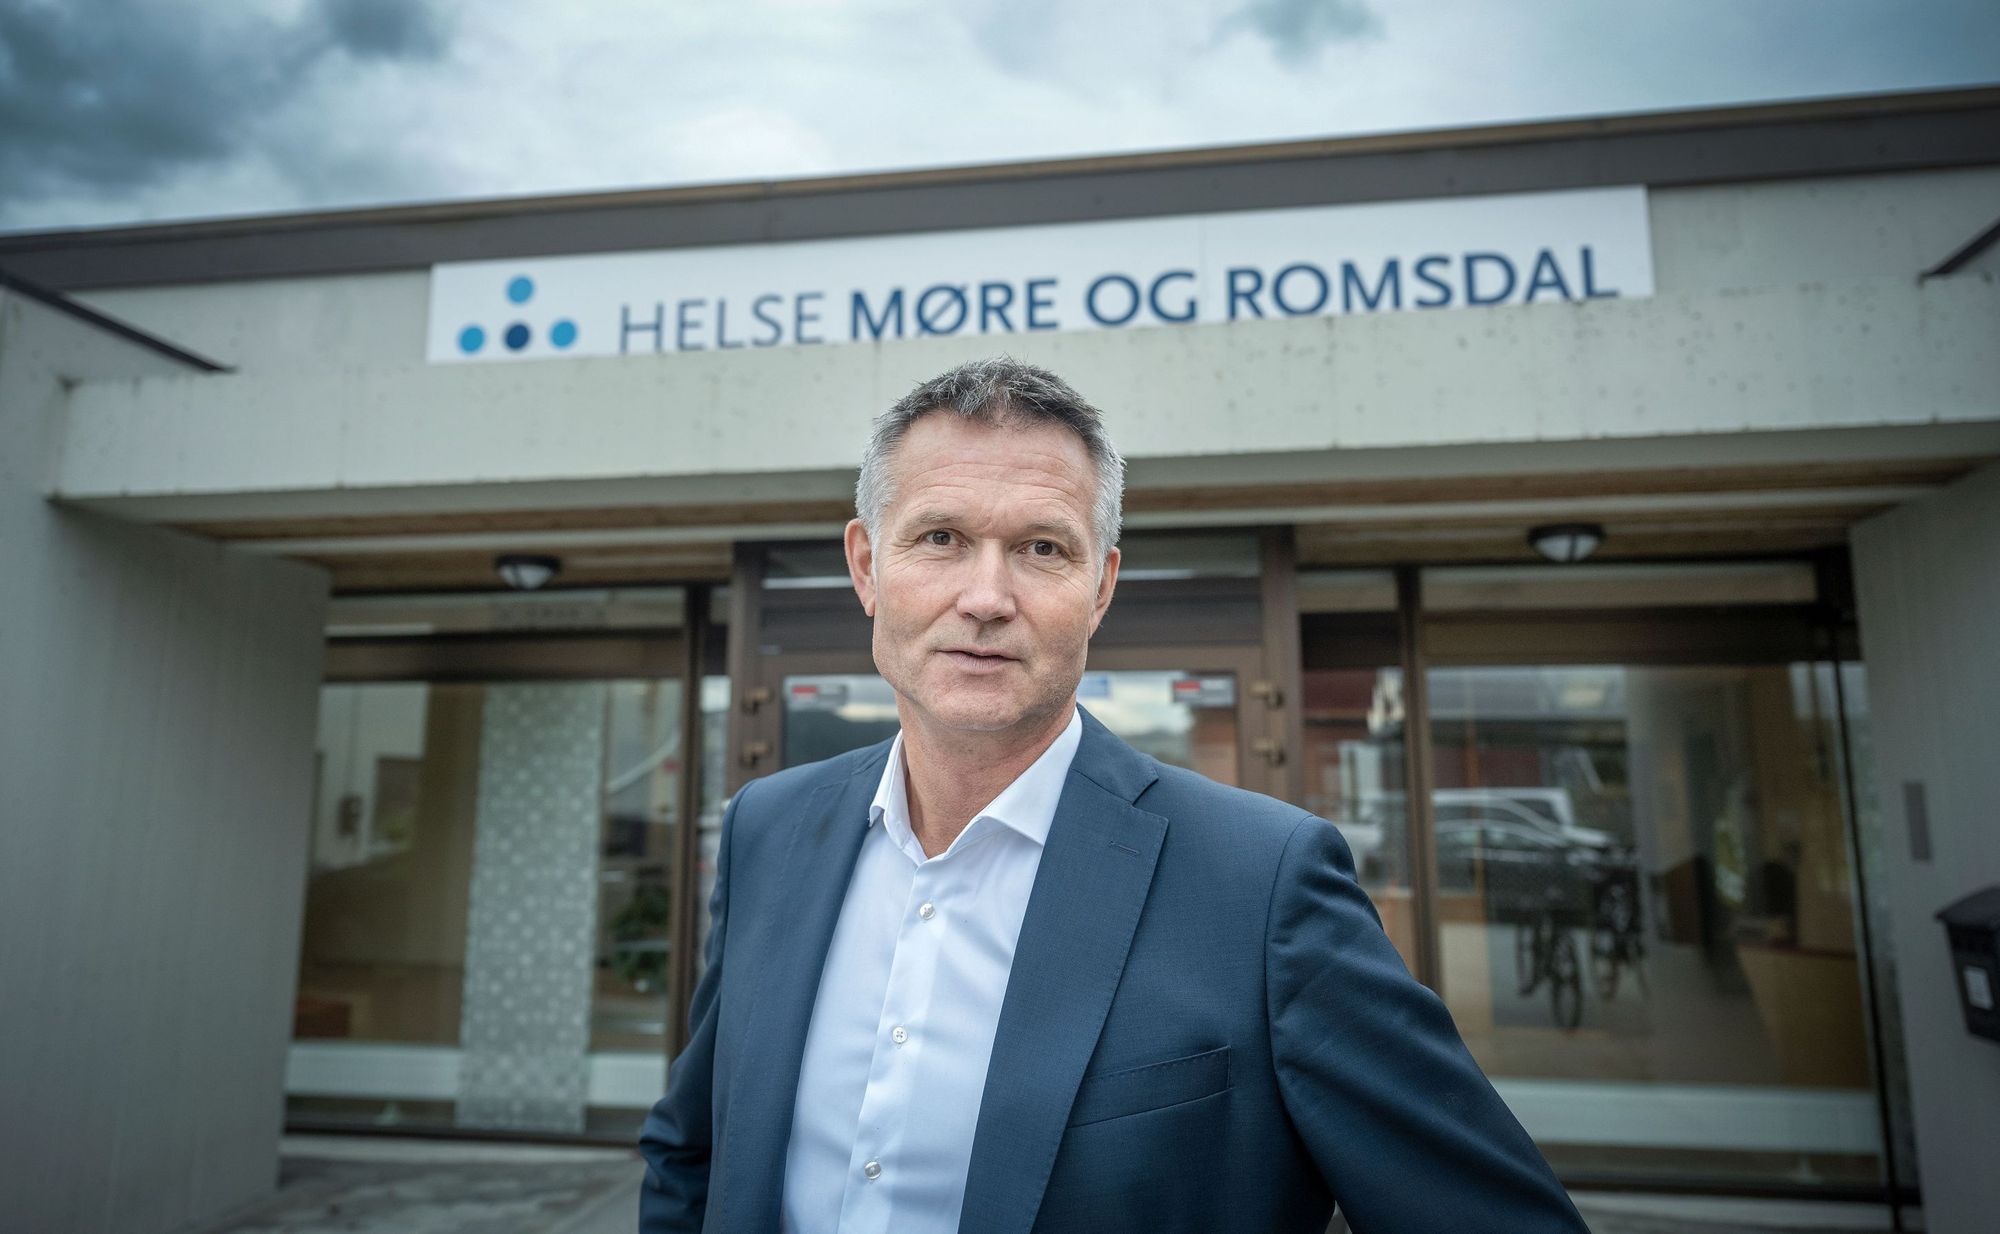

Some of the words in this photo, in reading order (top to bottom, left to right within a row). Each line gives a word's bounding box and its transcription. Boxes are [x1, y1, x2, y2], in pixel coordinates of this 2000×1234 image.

[619, 292, 824, 353] HELSE
[850, 277, 1058, 341] MØRE
[1085, 269, 1199, 328] OG
[1225, 244, 1619, 321] ROMSDAL
